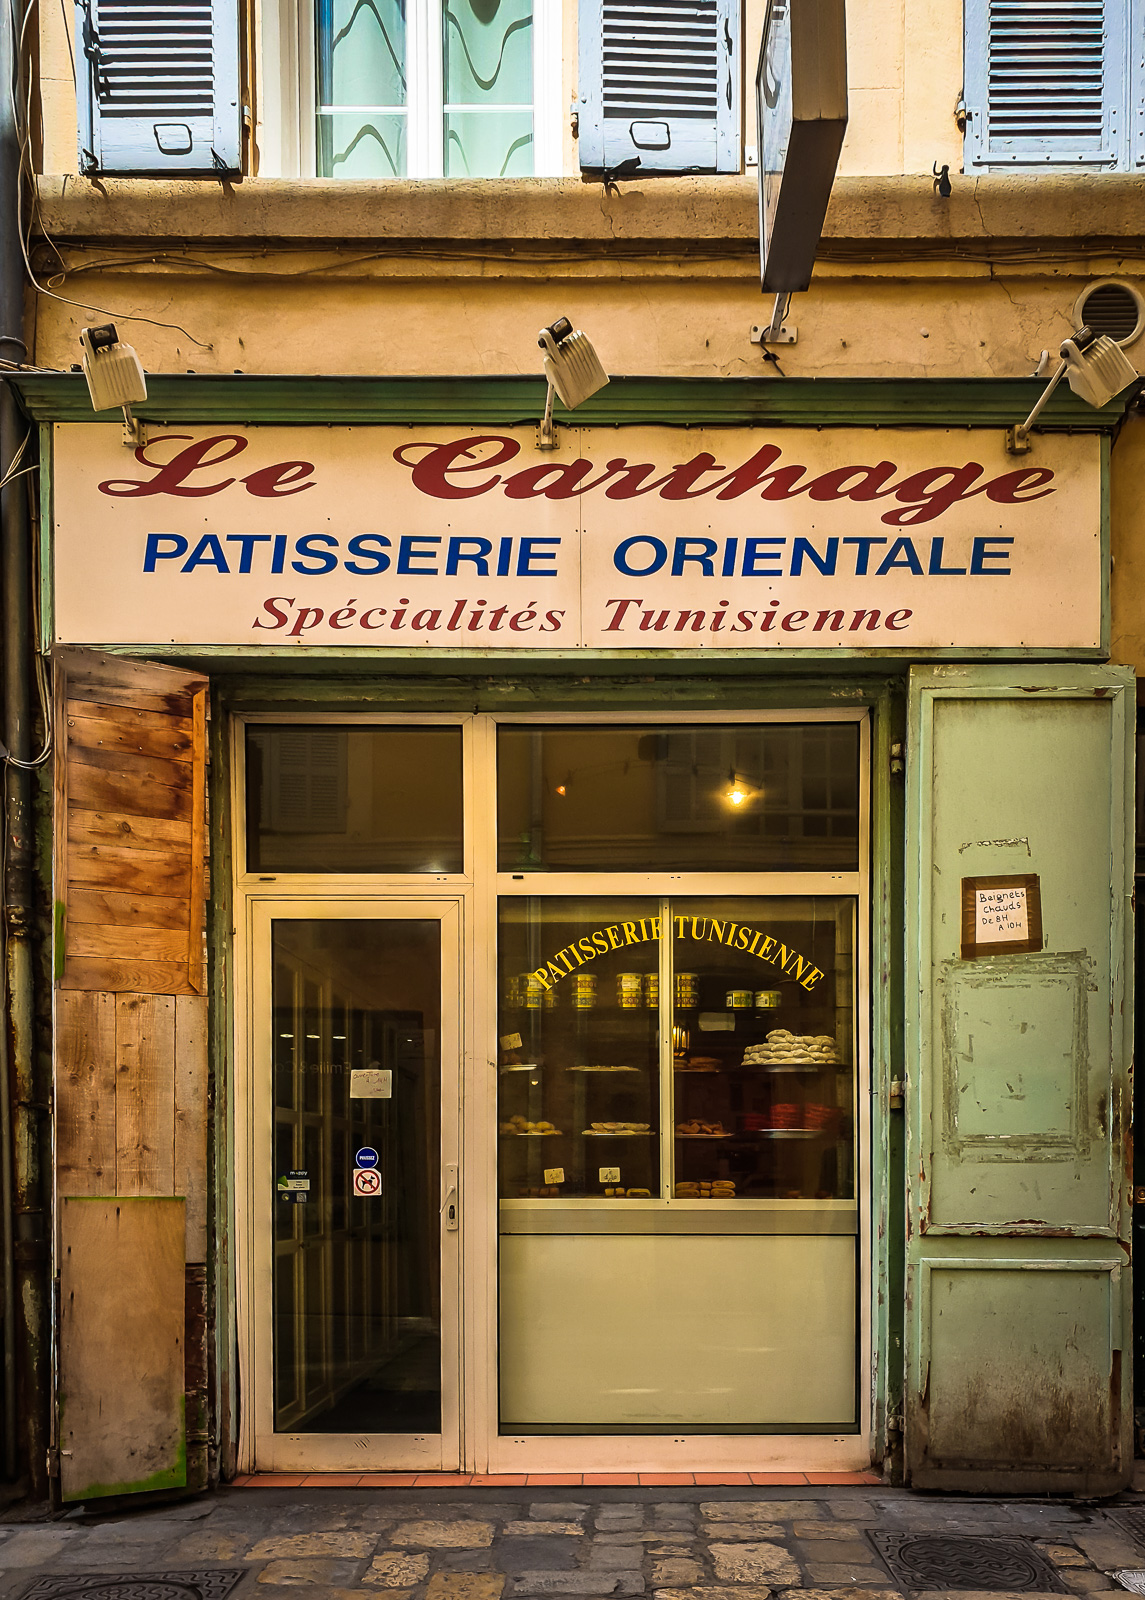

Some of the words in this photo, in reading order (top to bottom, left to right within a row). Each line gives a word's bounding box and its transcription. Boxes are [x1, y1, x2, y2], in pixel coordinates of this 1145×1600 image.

[98, 434, 317, 497] Le
[393, 435, 1057, 526] Carthage
[143, 533, 562, 576] PATISSERIE
[613, 535, 1015, 577] ORIENTALE
[253, 596, 565, 637] Spécialités
[601, 599, 913, 632] Tunisienne
[980, 891, 1024, 903] Beignets
[996, 914, 1008, 922] 8H
[533, 916, 664, 992] PATISSERIE
[674, 915, 825, 992] TUNISIENNE
